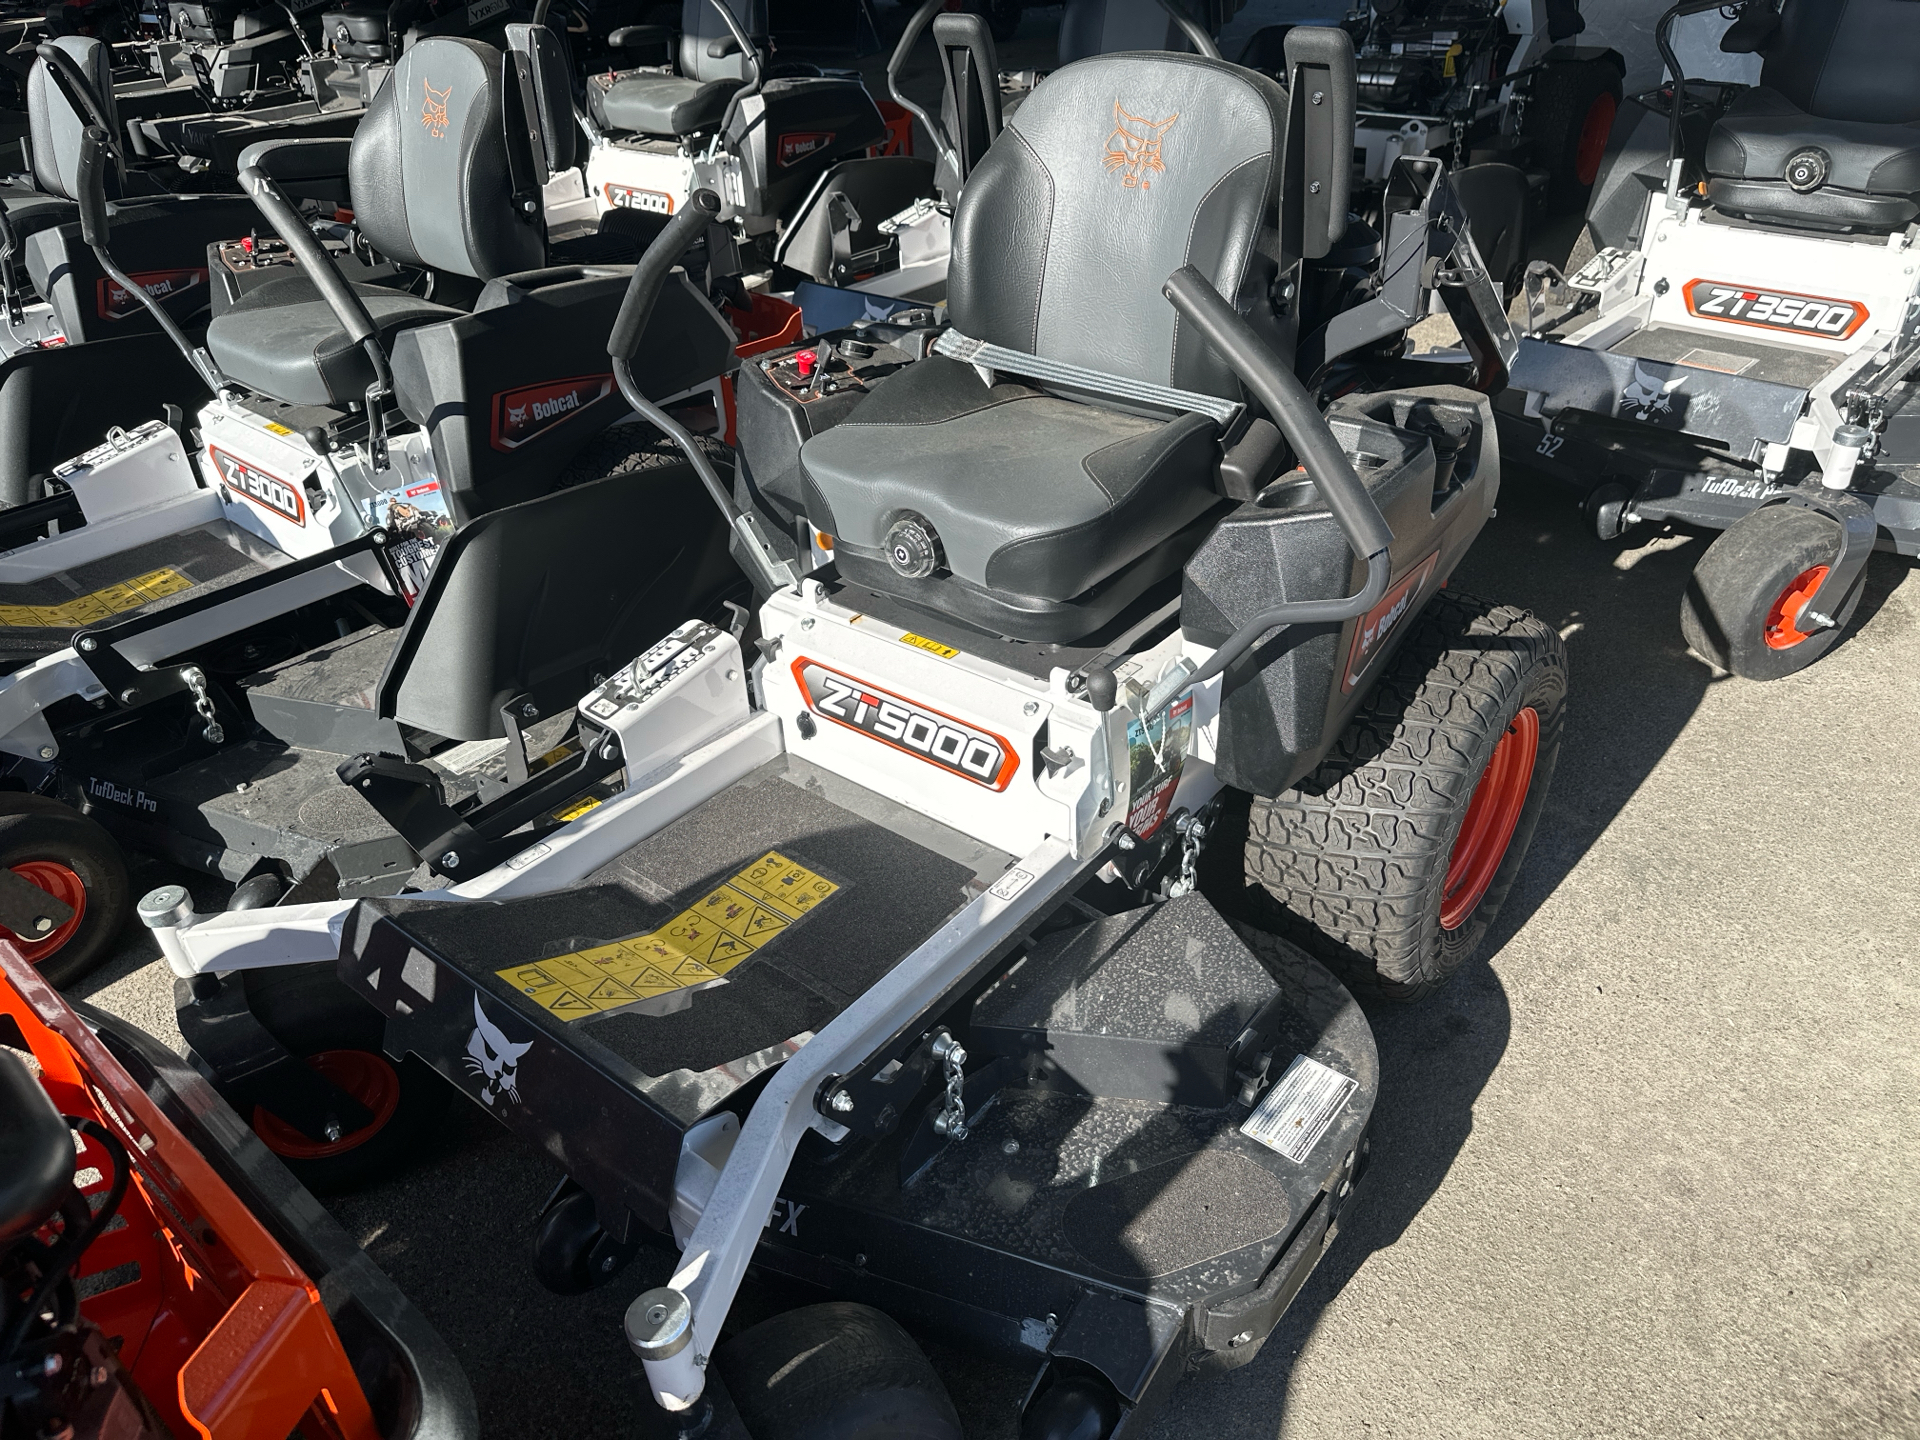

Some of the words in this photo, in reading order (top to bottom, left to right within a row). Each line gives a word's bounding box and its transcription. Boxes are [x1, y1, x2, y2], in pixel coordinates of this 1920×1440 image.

[613, 188, 670, 215] ZT2000
[1698, 287, 1855, 332] ZT3500
[531, 389, 581, 422] Bobcat
[1535, 433, 1565, 459] 52
[222, 455, 299, 518] ZT3000
[391, 536, 435, 560] TOUGHEST
[1376, 588, 1410, 641] Bobcat
[817, 676, 1002, 779] ZT5000
[89, 776, 134, 807] TufDeck
[135, 789, 158, 813] Pro
[1132, 789, 1153, 812] YOUR
[1129, 796, 1160, 830] YOUR
